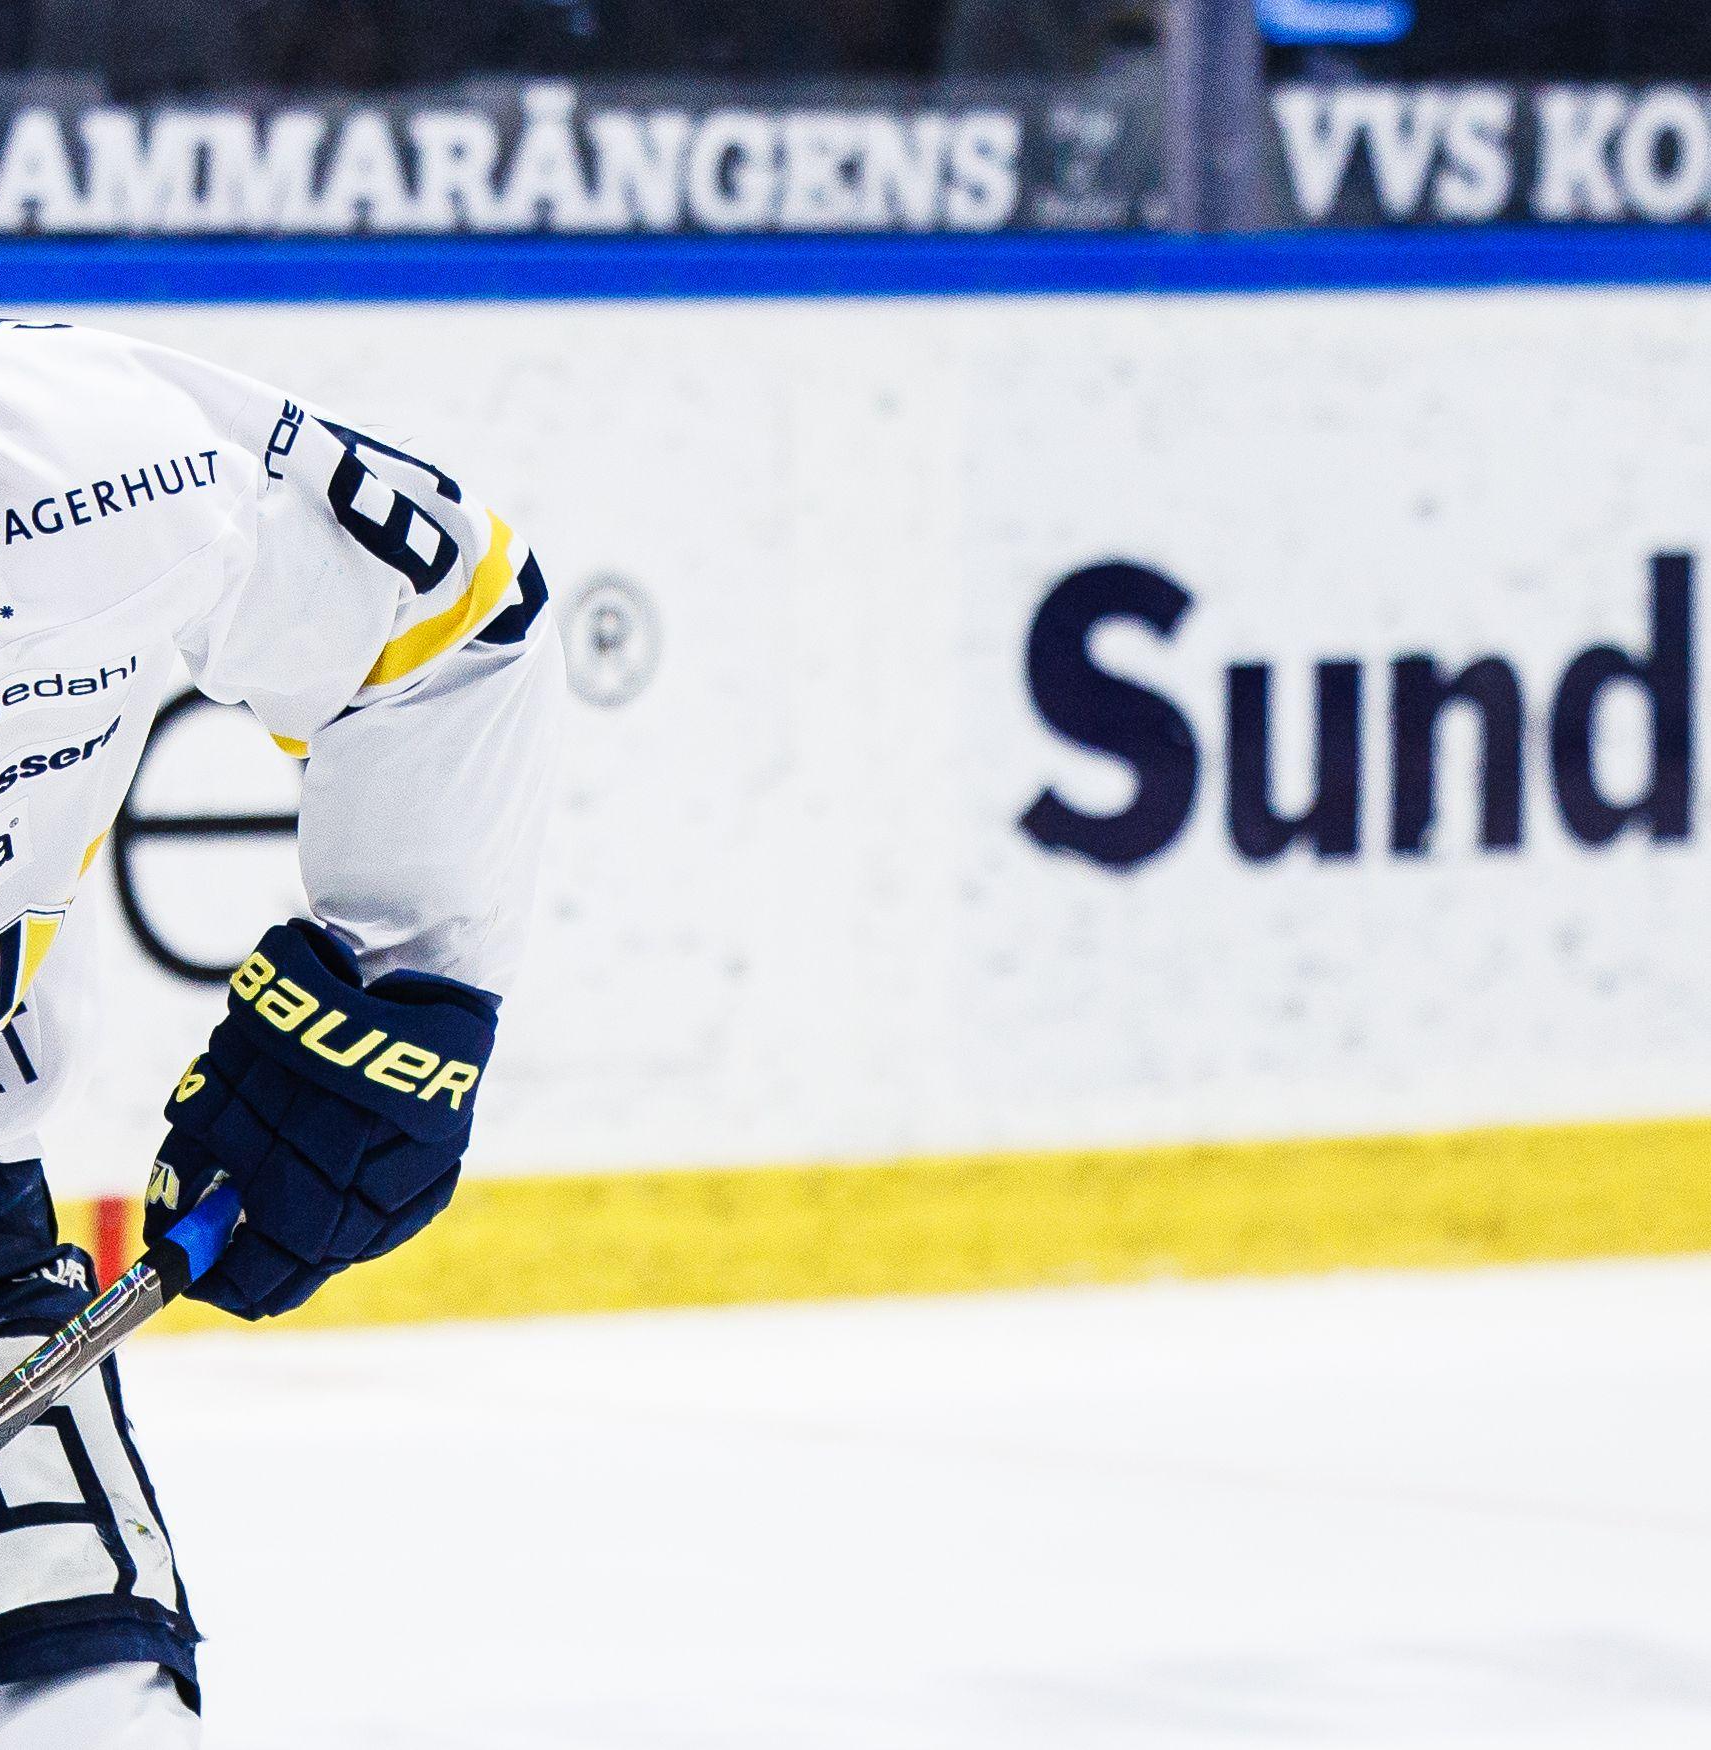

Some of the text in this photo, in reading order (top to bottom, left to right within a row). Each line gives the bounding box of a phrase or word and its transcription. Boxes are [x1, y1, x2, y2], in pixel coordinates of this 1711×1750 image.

[1273, 84, 1514, 221] VVS
[1018, 553, 1694, 871] Sund
[230, 951, 479, 1111] BAUER
